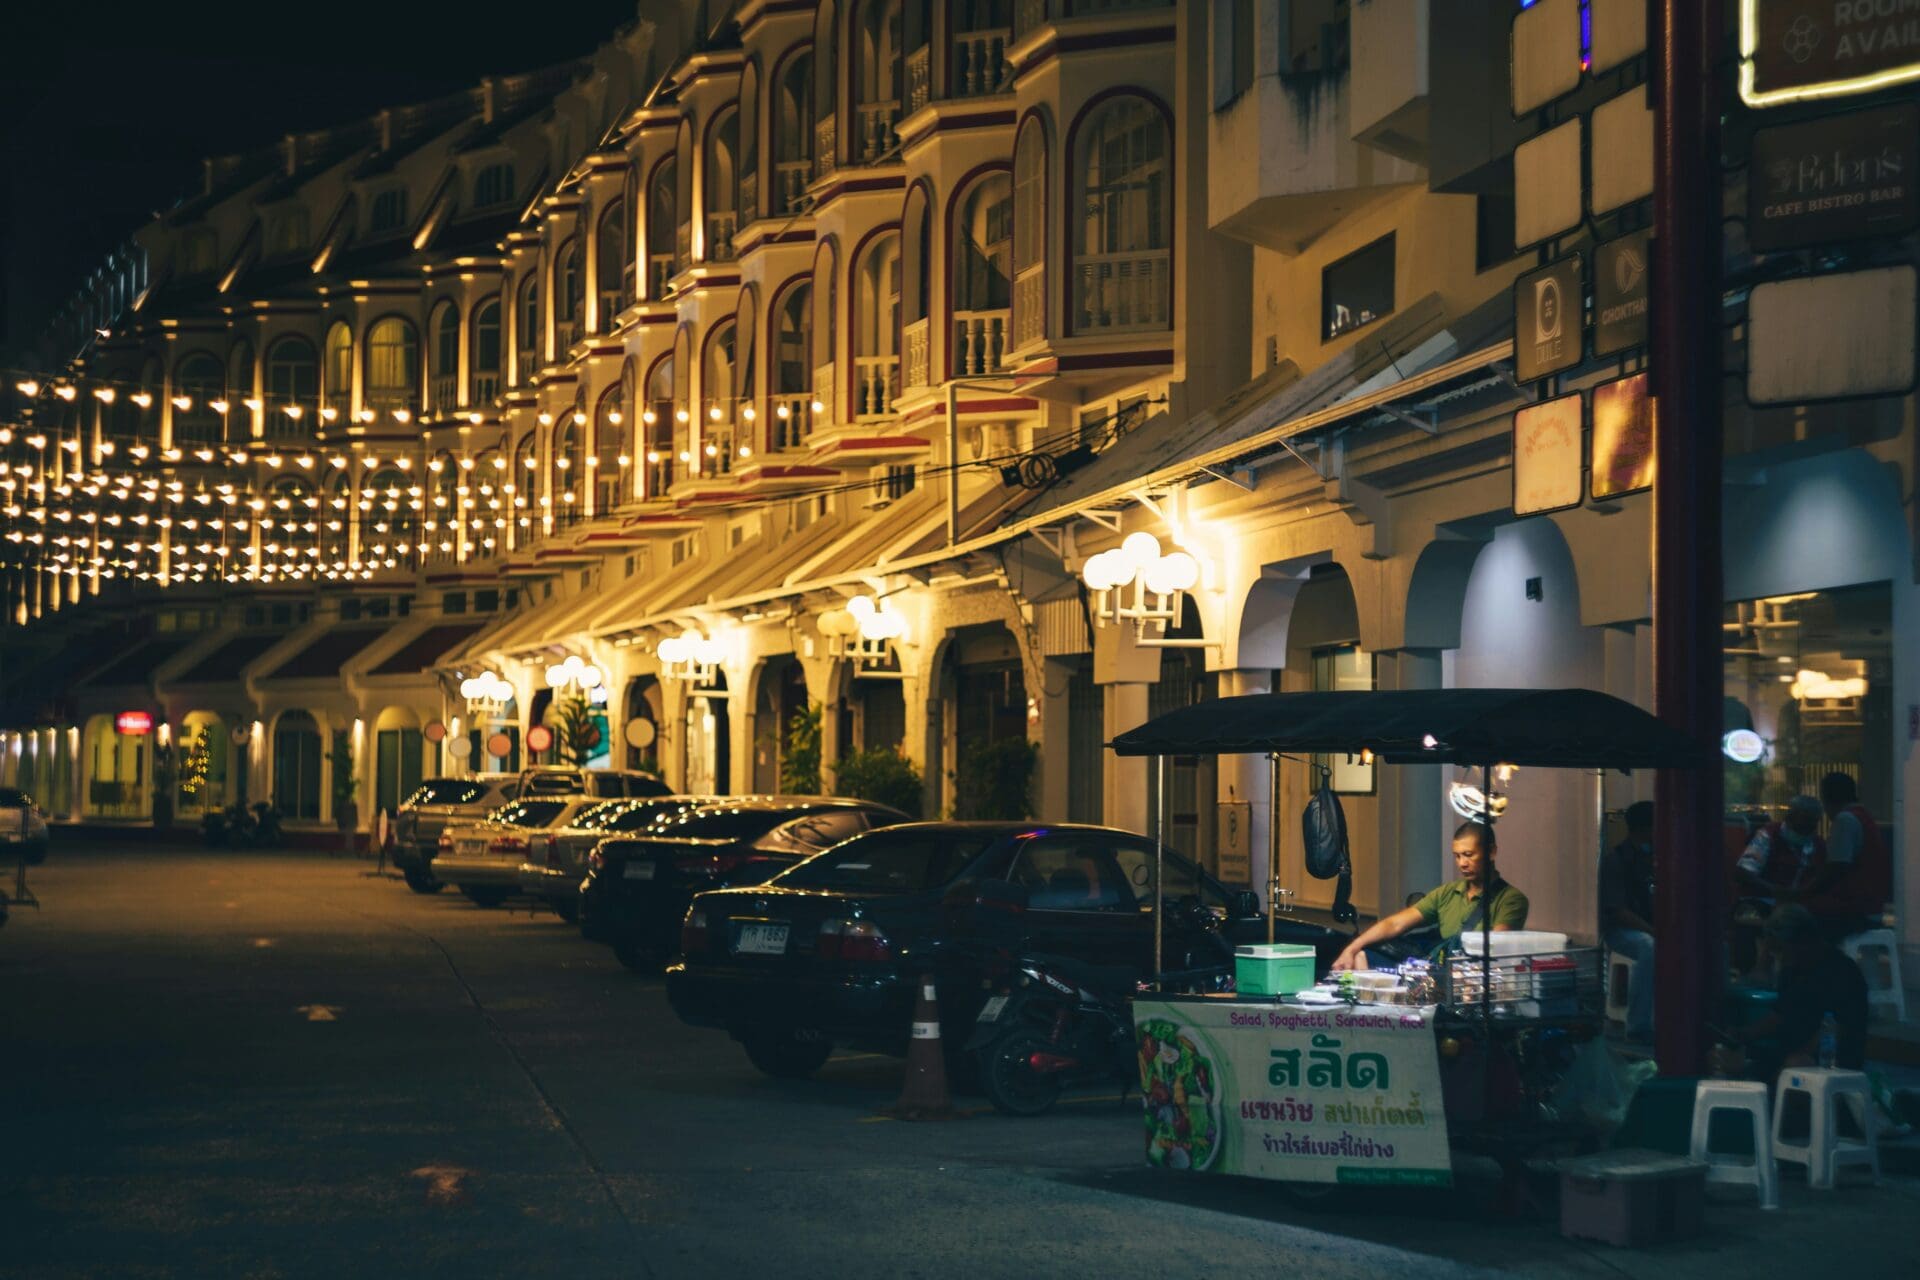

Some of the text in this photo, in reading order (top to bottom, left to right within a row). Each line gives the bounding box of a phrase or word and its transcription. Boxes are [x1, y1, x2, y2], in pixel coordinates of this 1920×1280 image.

[1763, 186, 1905, 219] CAFE BISTRO BAR
[1230, 1012, 1426, 1031] Salad, Spaghetti, Sandwich, Rice
[1268, 1034, 1389, 1090] สลัด
[1241, 1090, 1425, 1125] แซนวิช สปาเก็ตตี้
